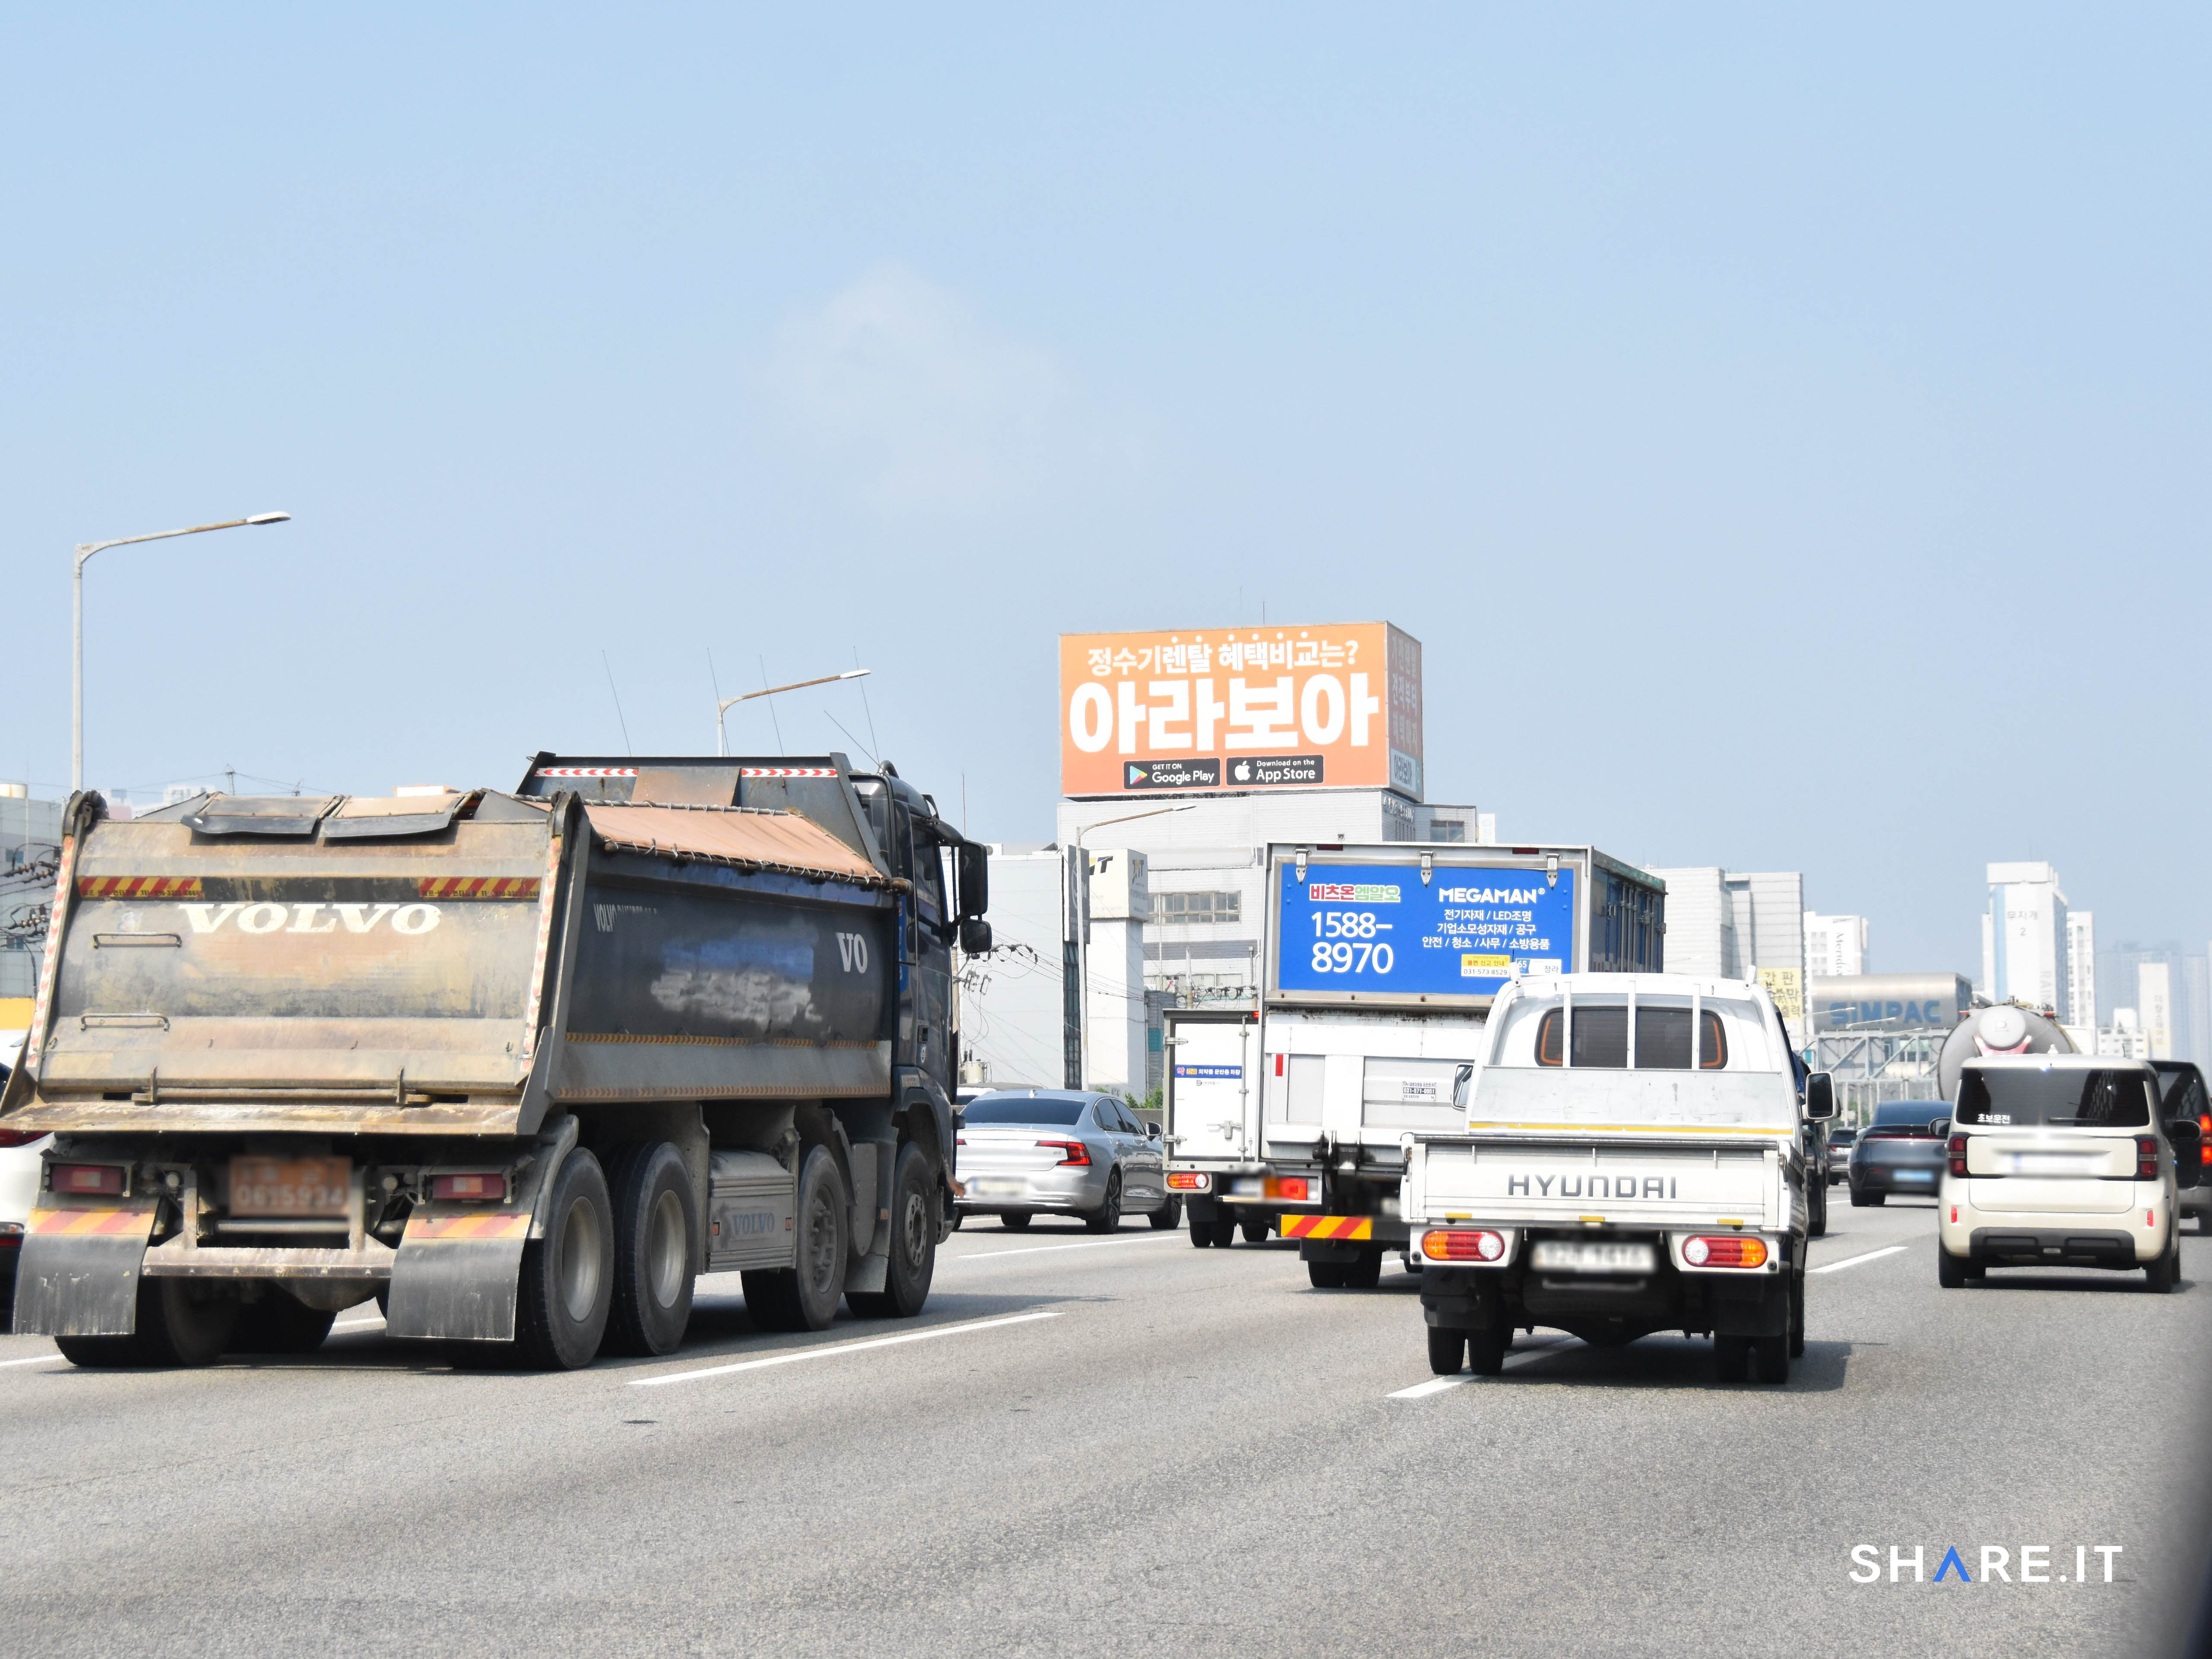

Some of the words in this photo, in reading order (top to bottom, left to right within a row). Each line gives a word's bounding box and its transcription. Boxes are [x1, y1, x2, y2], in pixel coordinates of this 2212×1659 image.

[1088, 644, 1211, 675] 정수기렌탈
[1219, 640, 1359, 670] 혜택비교는?
[1069, 672, 1379, 754] 아라보아
[1152, 770, 1191, 785] Google
[1193, 769, 1214, 784] Play
[1256, 769, 1281, 782] App
[1283, 768, 1315, 779] Store
[1310, 884, 1401, 902] 비츠온엠알오
[177, 902, 442, 935] VOLVO
[1444, 909, 1484, 921] 전기자재
[1493, 910, 1532, 922] LED조명
[2007, 911, 2038, 921] 무지개
[1312, 912, 1393, 938] 1588-
[1437, 923, 1507, 935] 기업소모성자재
[1515, 924, 1536, 935] 공구
[2020, 928, 2026, 936] 2
[1422, 936, 1442, 948] 안전
[1451, 937, 1471, 948] 청소
[1480, 938, 1500, 949] 사무
[1508, 938, 1550, 950] 소방용품
[836, 932, 868, 974] VO
[1312, 943, 1394, 974] 8970
[1518, 960, 1527, 969] 65
[1544, 966, 1559, 974] 청라
[2040, 971, 2052, 1004] RAIN
[1830, 1000, 1941, 1025] SIMPAC
[1176, 1067, 1185, 1076] 약
[1977, 1113, 2010, 1124] 초보운전
[1508, 1173, 1676, 1199] HYUNDAI
[732, 1212, 776, 1235] VOLVO
